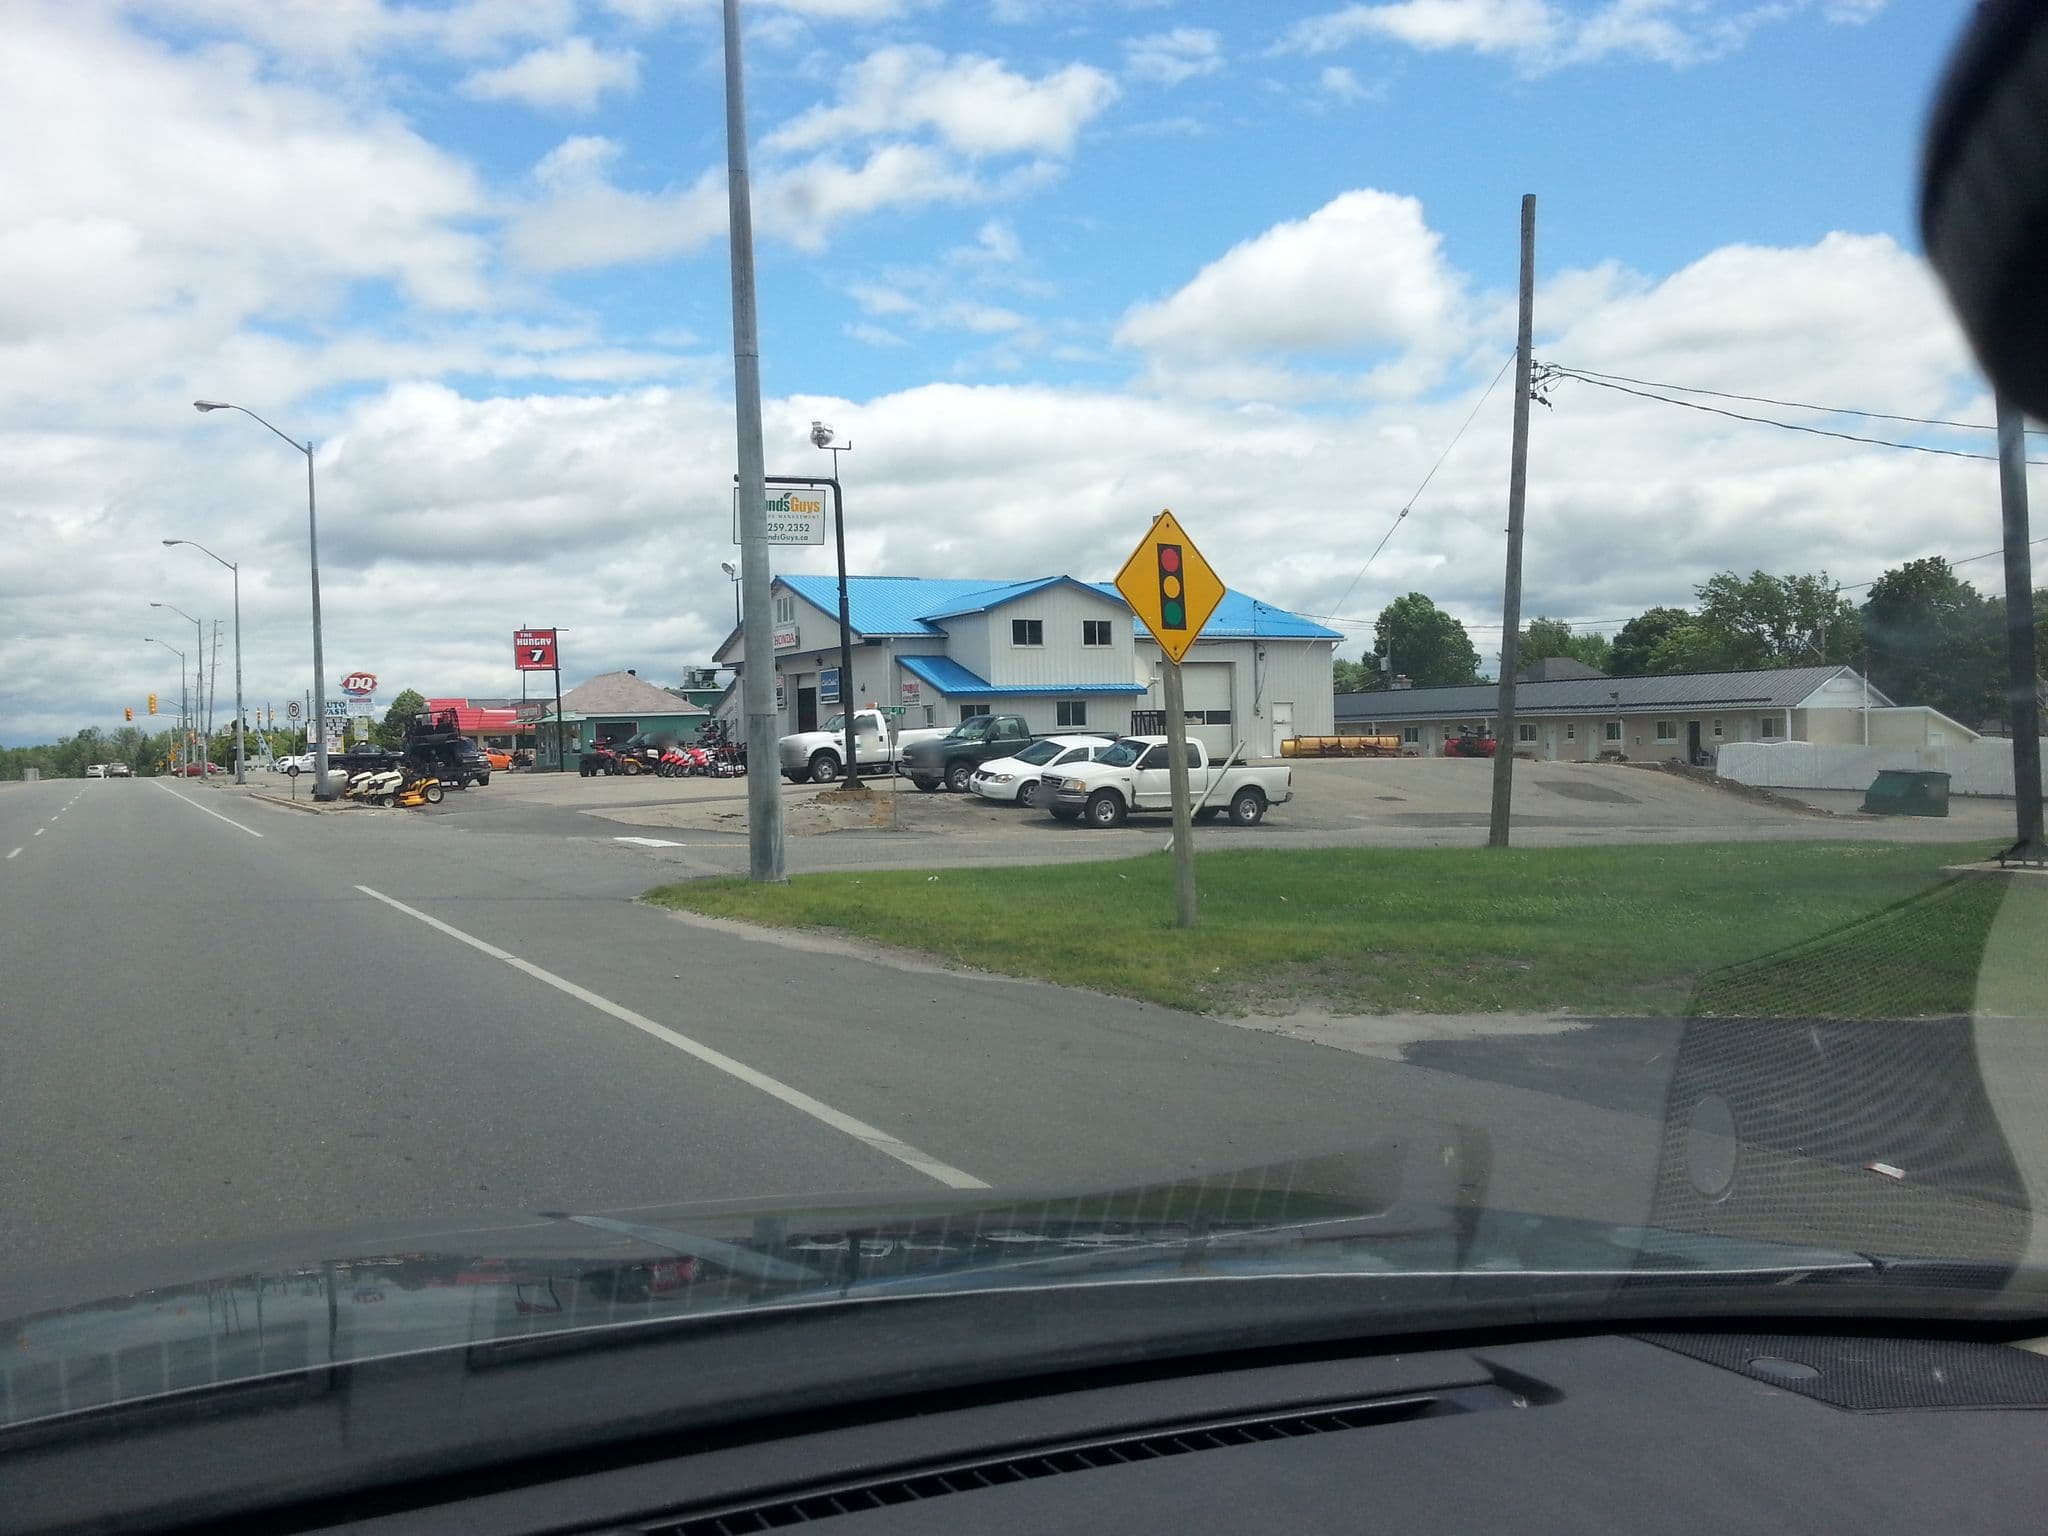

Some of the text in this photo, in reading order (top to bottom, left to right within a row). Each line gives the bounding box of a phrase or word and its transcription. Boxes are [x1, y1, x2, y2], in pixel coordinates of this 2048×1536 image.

[766, 496, 820, 513] ndsGuys
[768, 523, 810, 532] 259.2352
[517, 638, 552, 646] HUNGRY
[531, 649, 543, 662] 7
[349, 677, 373, 690] DQ
